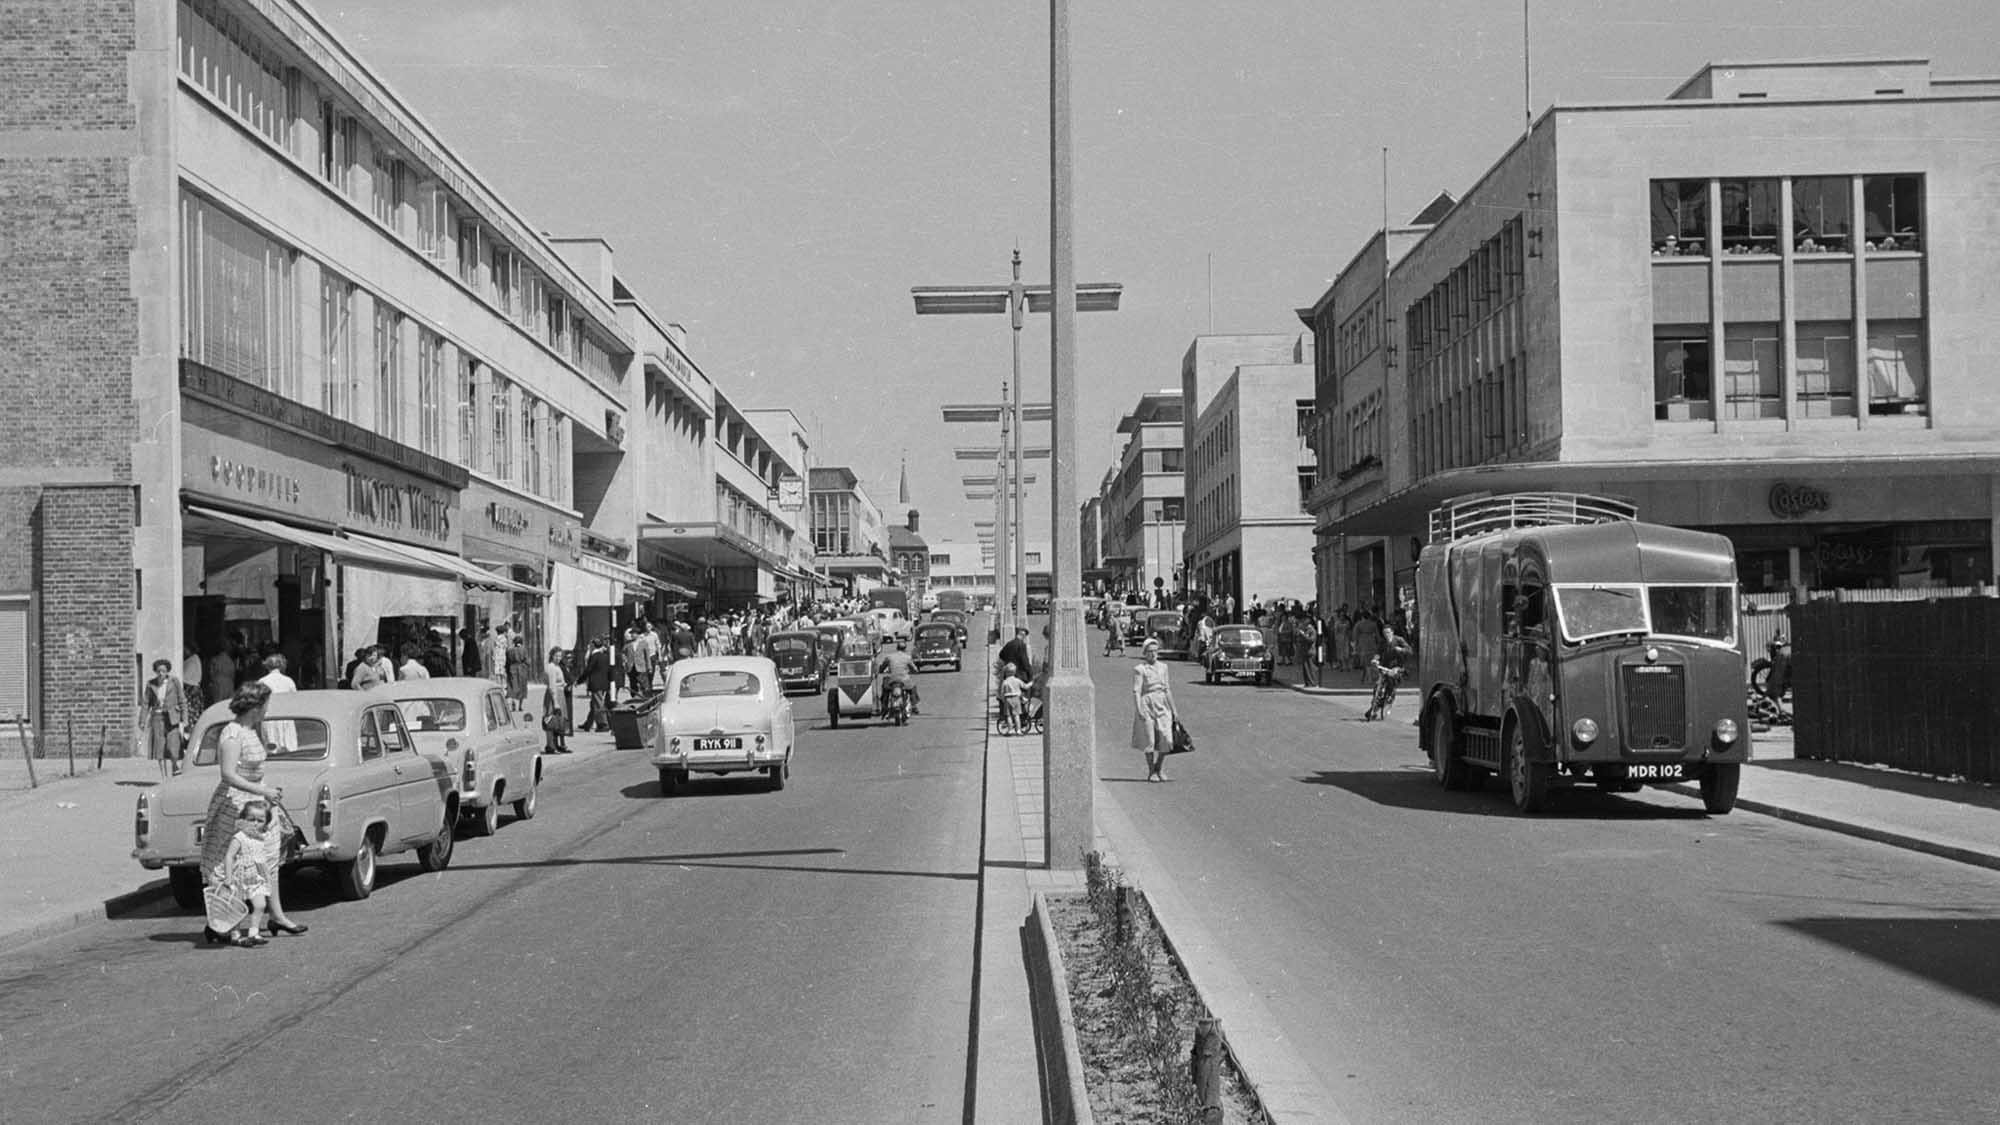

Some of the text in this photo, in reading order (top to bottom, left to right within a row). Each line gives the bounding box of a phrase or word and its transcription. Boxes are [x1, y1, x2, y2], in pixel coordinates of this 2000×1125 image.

[700, 739, 736, 750] RYK 911
[1628, 764, 1683, 778] MDR 102
